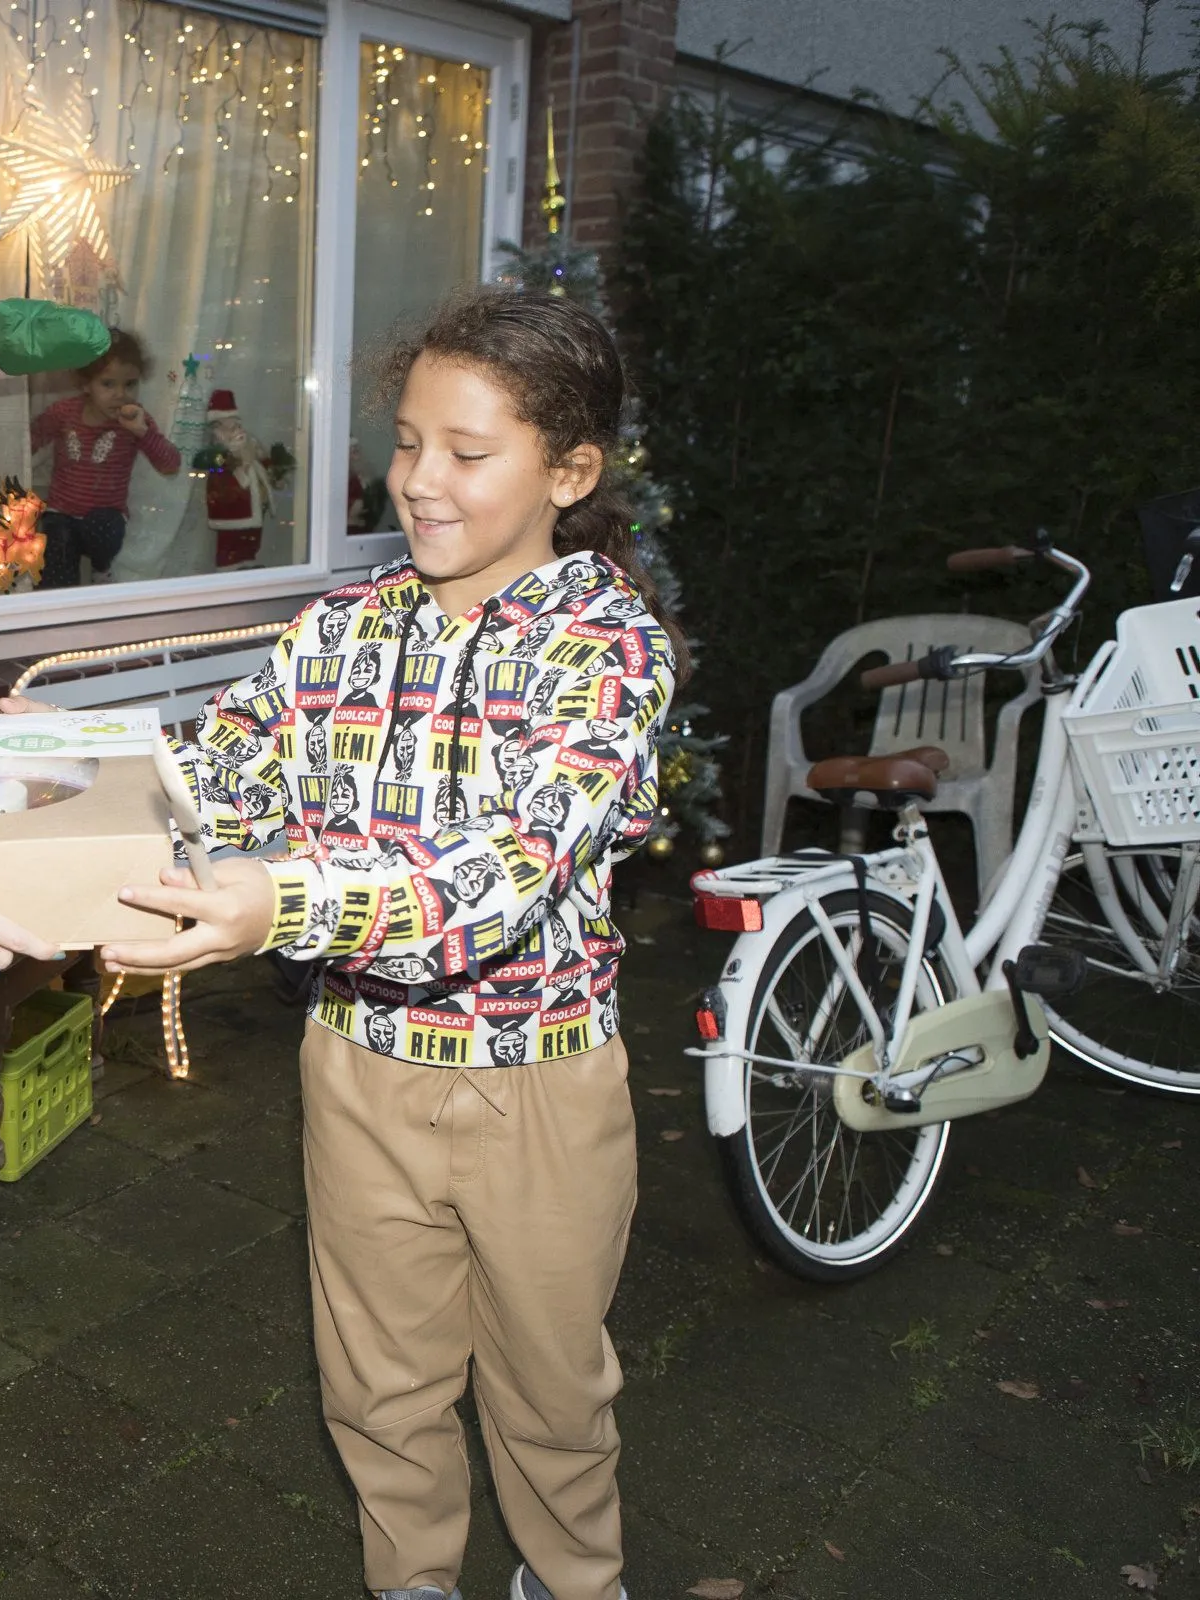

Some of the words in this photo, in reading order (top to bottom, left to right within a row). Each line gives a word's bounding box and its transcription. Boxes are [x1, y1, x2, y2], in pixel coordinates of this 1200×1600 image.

[546, 639, 597, 668] RÉM
[301, 656, 345, 689] RÉMI
[404, 655, 439, 689] RÉM
[489, 661, 535, 699] ÉMI
[301, 692, 337, 705] COOLCAT
[400, 696, 433, 708] COOLCA
[336, 710, 380, 722] COOLCAT
[487, 704, 522, 716] OLCAT
[220, 712, 253, 735] COOLC
[434, 718, 481, 733] COOCAT
[334, 726, 375, 761] RÉMI
[560, 751, 623, 773] COOLCAT
[377, 784, 418, 820] RÉMI
[322, 834, 364, 849] COOLCAT
[412, 876, 439, 932] COOLCAT
[328, 890, 373, 950] RÉMI
[468, 917, 504, 961] ÉMI
[588, 941, 622, 953] OLCAT
[447, 933, 463, 974] OLCAT
[488, 963, 543, 978] COOLCAT
[549, 964, 589, 986] COOLCAT
[359, 980, 405, 1000] COOLCAT
[320, 996, 352, 1035] RÉMI
[480, 1000, 538, 1012] COOLCAT
[542, 1002, 588, 1023] COOLCAT
[410, 1010, 469, 1027] COOLCAT
[410, 1028, 467, 1063] RÉMI
[542, 1023, 589, 1059] RÉMI
